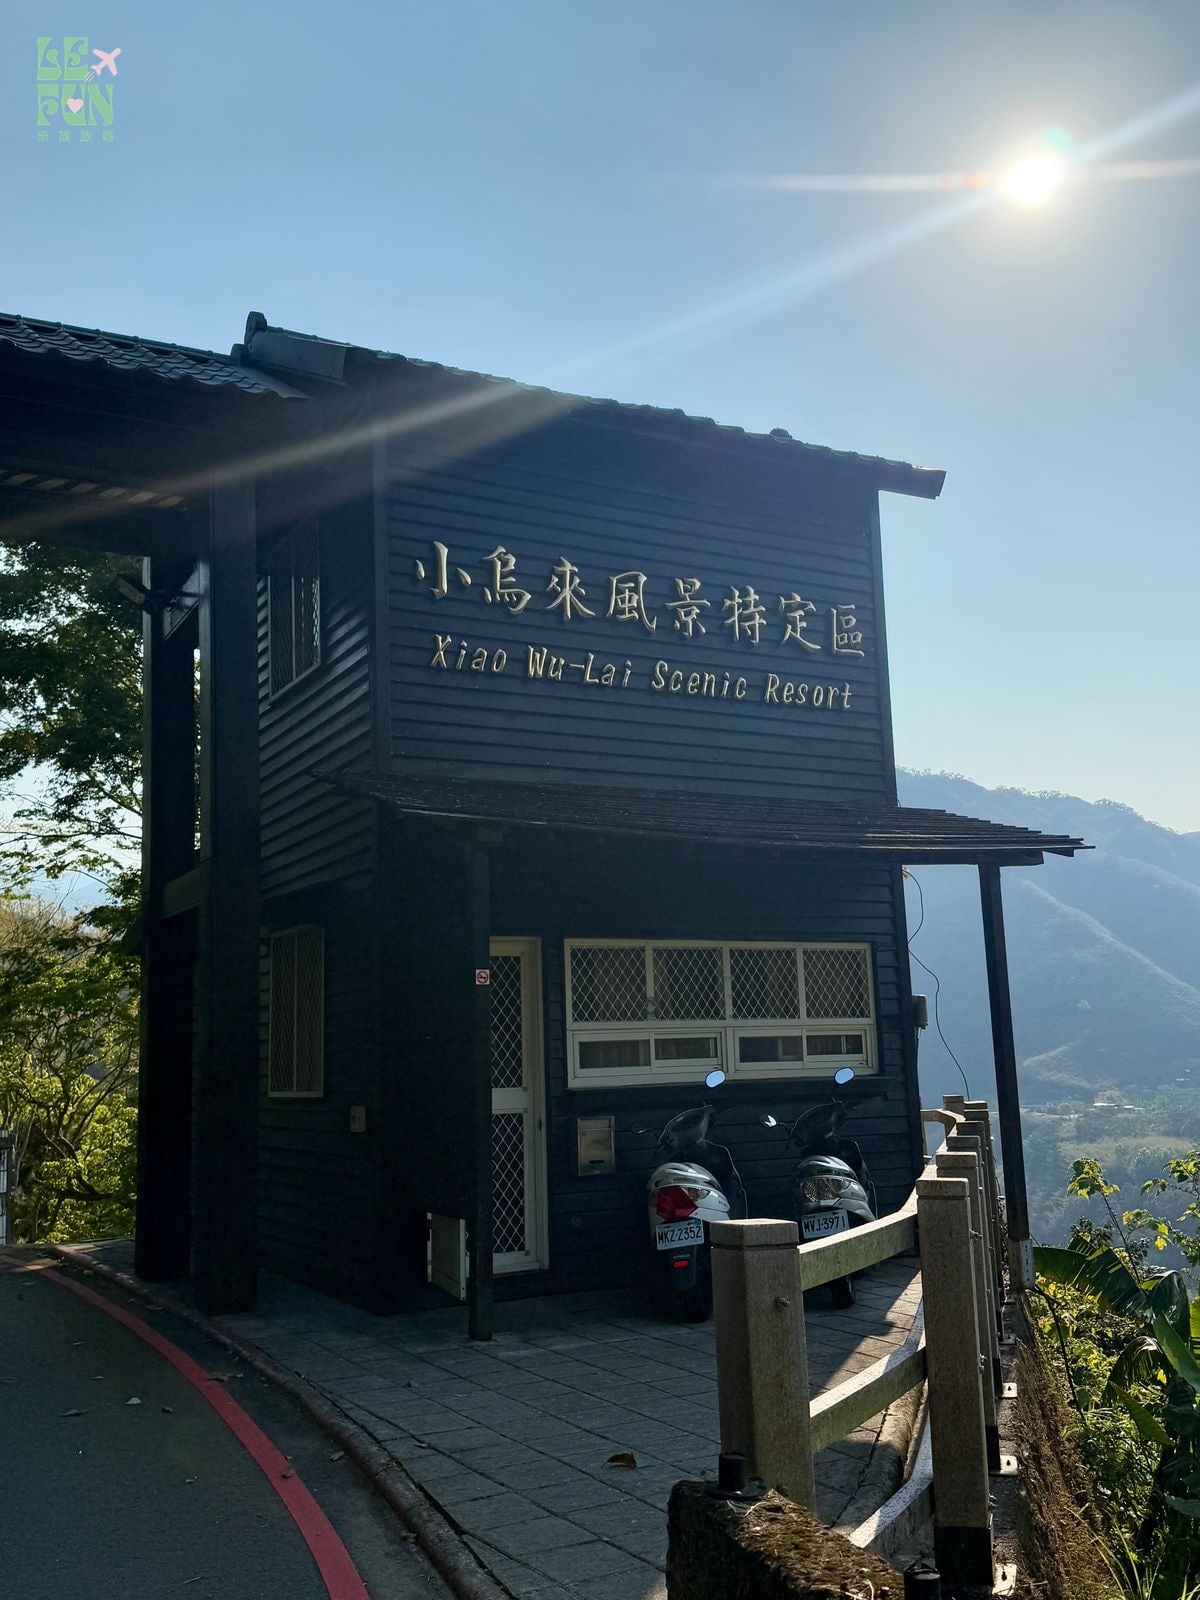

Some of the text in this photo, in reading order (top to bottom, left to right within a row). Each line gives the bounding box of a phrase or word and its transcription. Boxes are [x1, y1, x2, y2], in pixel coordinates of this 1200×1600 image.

[415, 541, 865, 657] 小烏來風景特定區
[430, 634, 852, 709] Xiao Wu-Lai Scenic Resort
